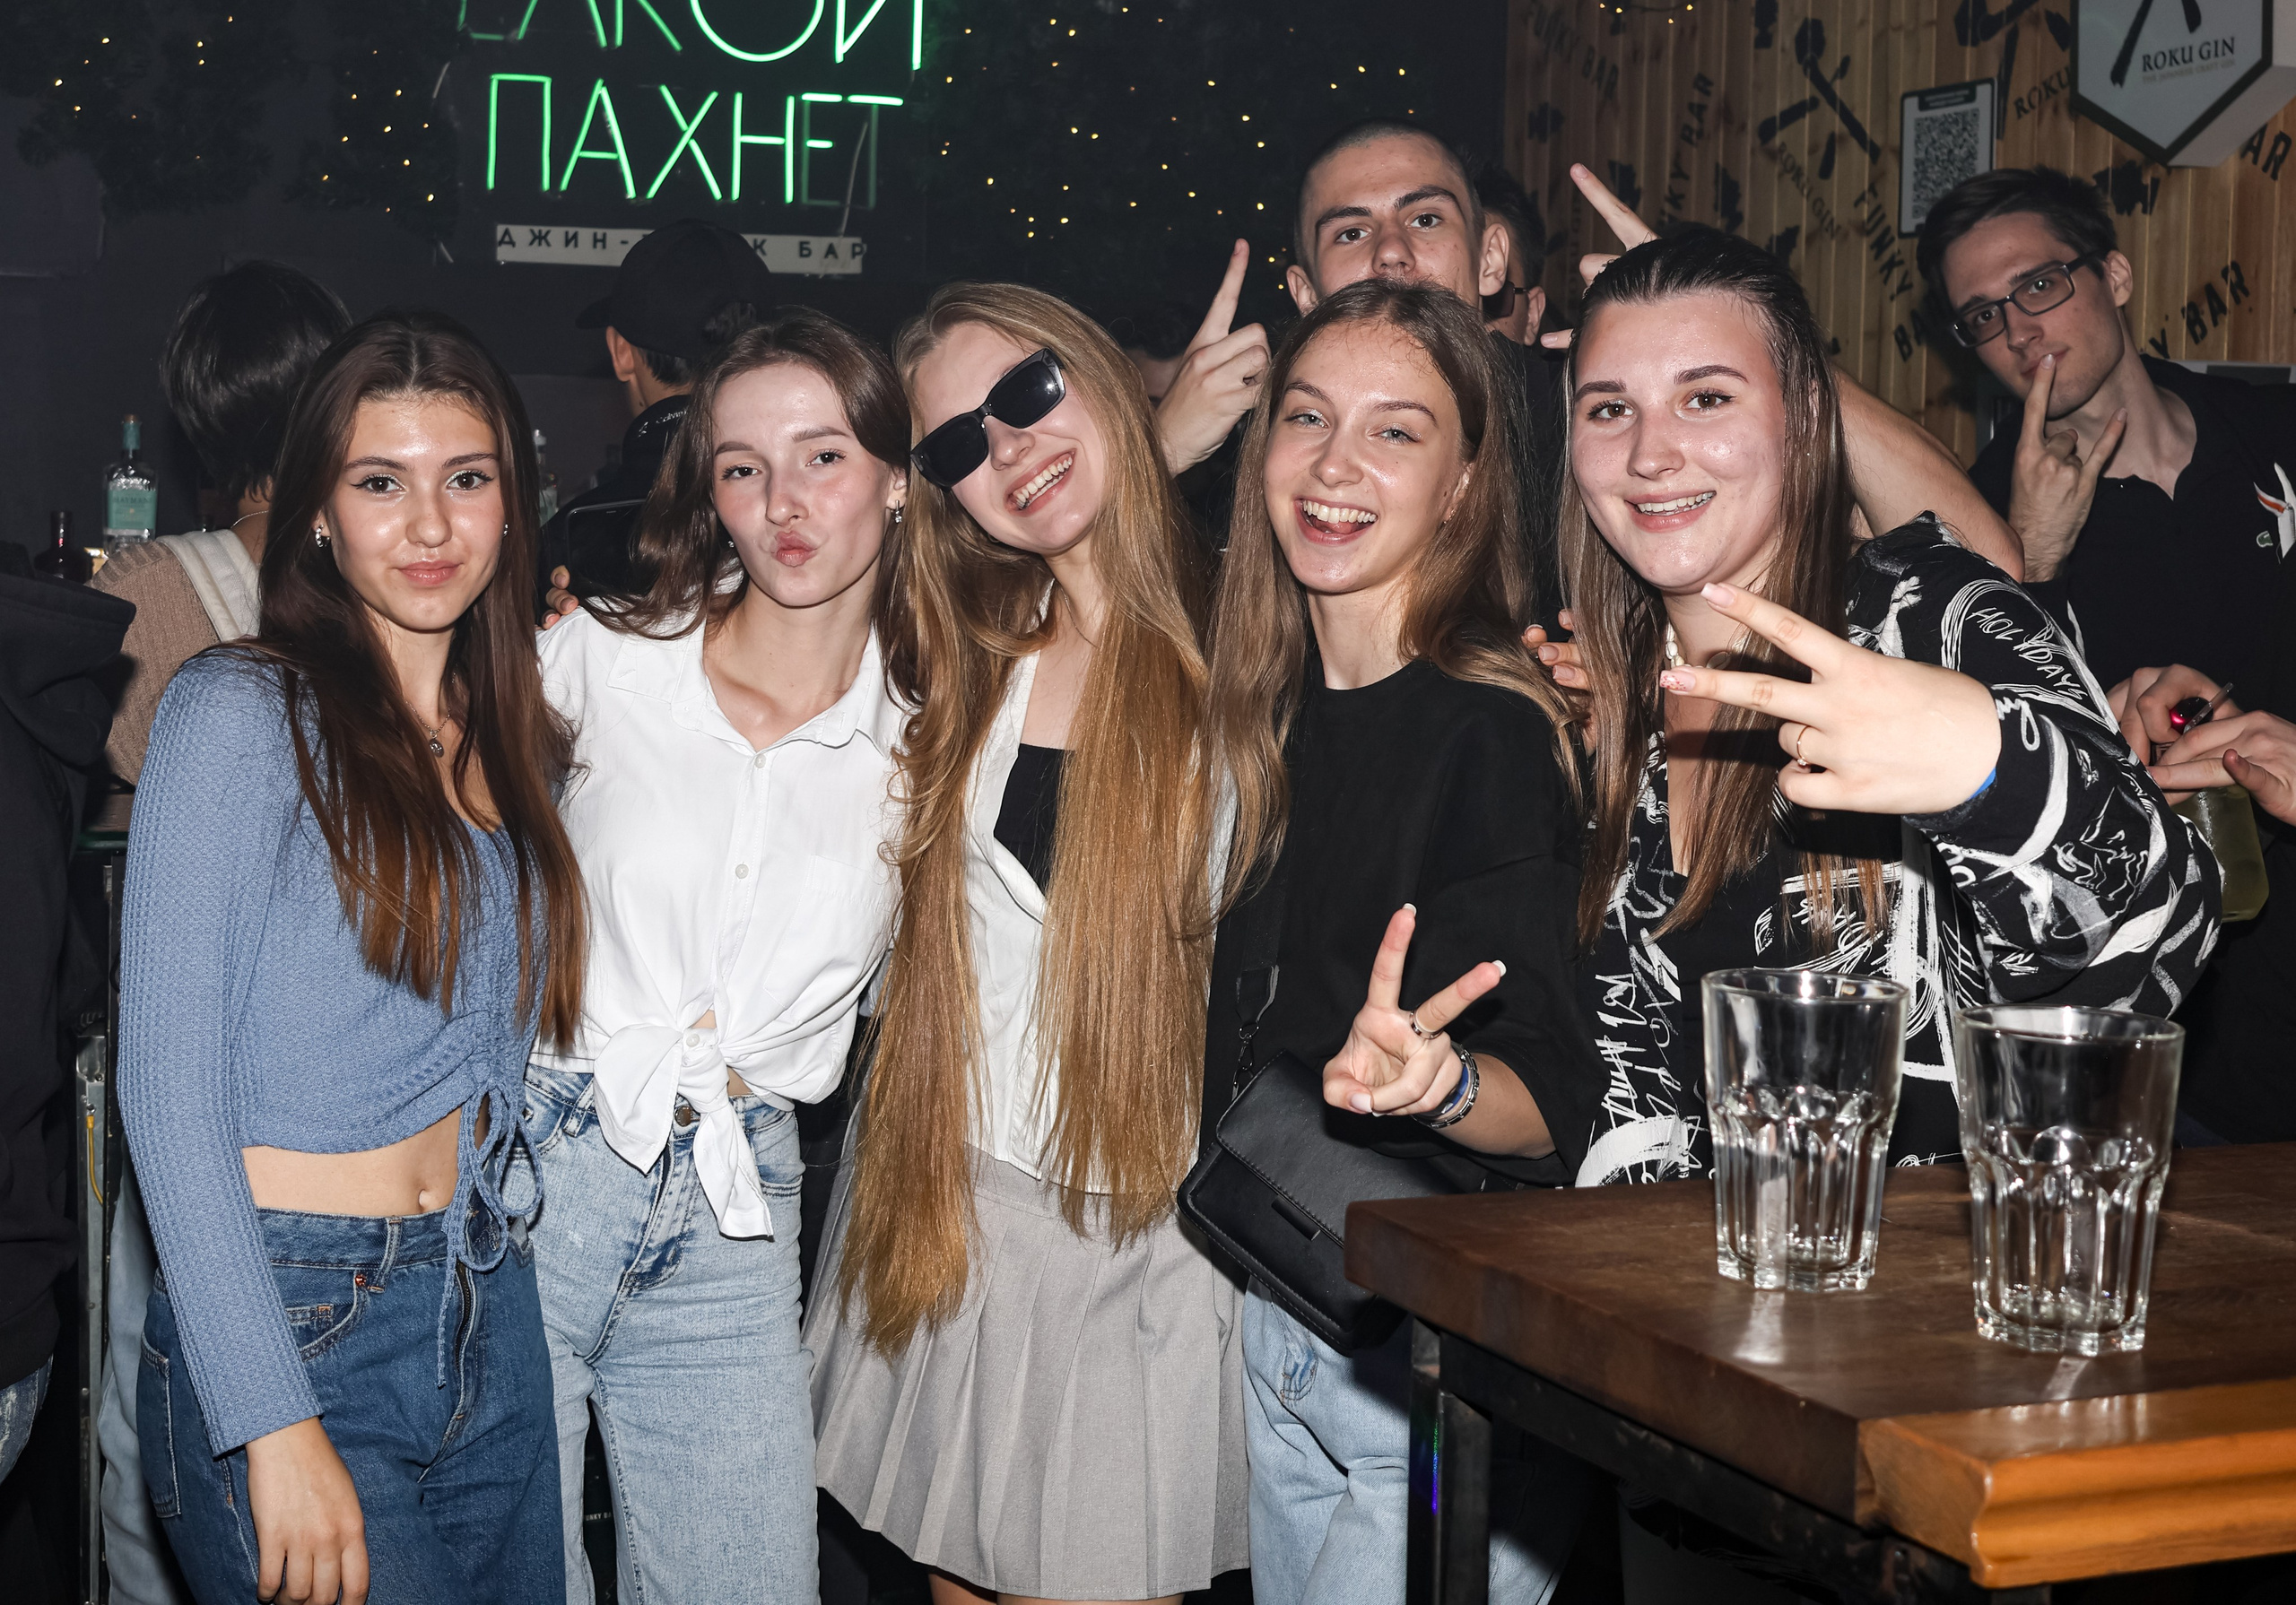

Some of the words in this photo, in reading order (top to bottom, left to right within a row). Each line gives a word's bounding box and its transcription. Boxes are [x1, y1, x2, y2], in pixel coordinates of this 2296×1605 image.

[1581, 44, 1620, 100] BAR
[2142, 45, 2193, 73] ROKU
[2198, 36, 2235, 61] GIN
[1680, 72, 1715, 148] BAR
[2013, 65, 2070, 119] ROKU
[487, 74, 904, 210] ПАХНЕТ
[2240, 125, 2292, 181] AR
[1812, 196, 1841, 240] GIN
[798, 239, 866, 260] БАР
[1853, 182, 1914, 301] FUNKY
[1893, 308, 1926, 362] BA
[2180, 260, 2250, 345] BAR
